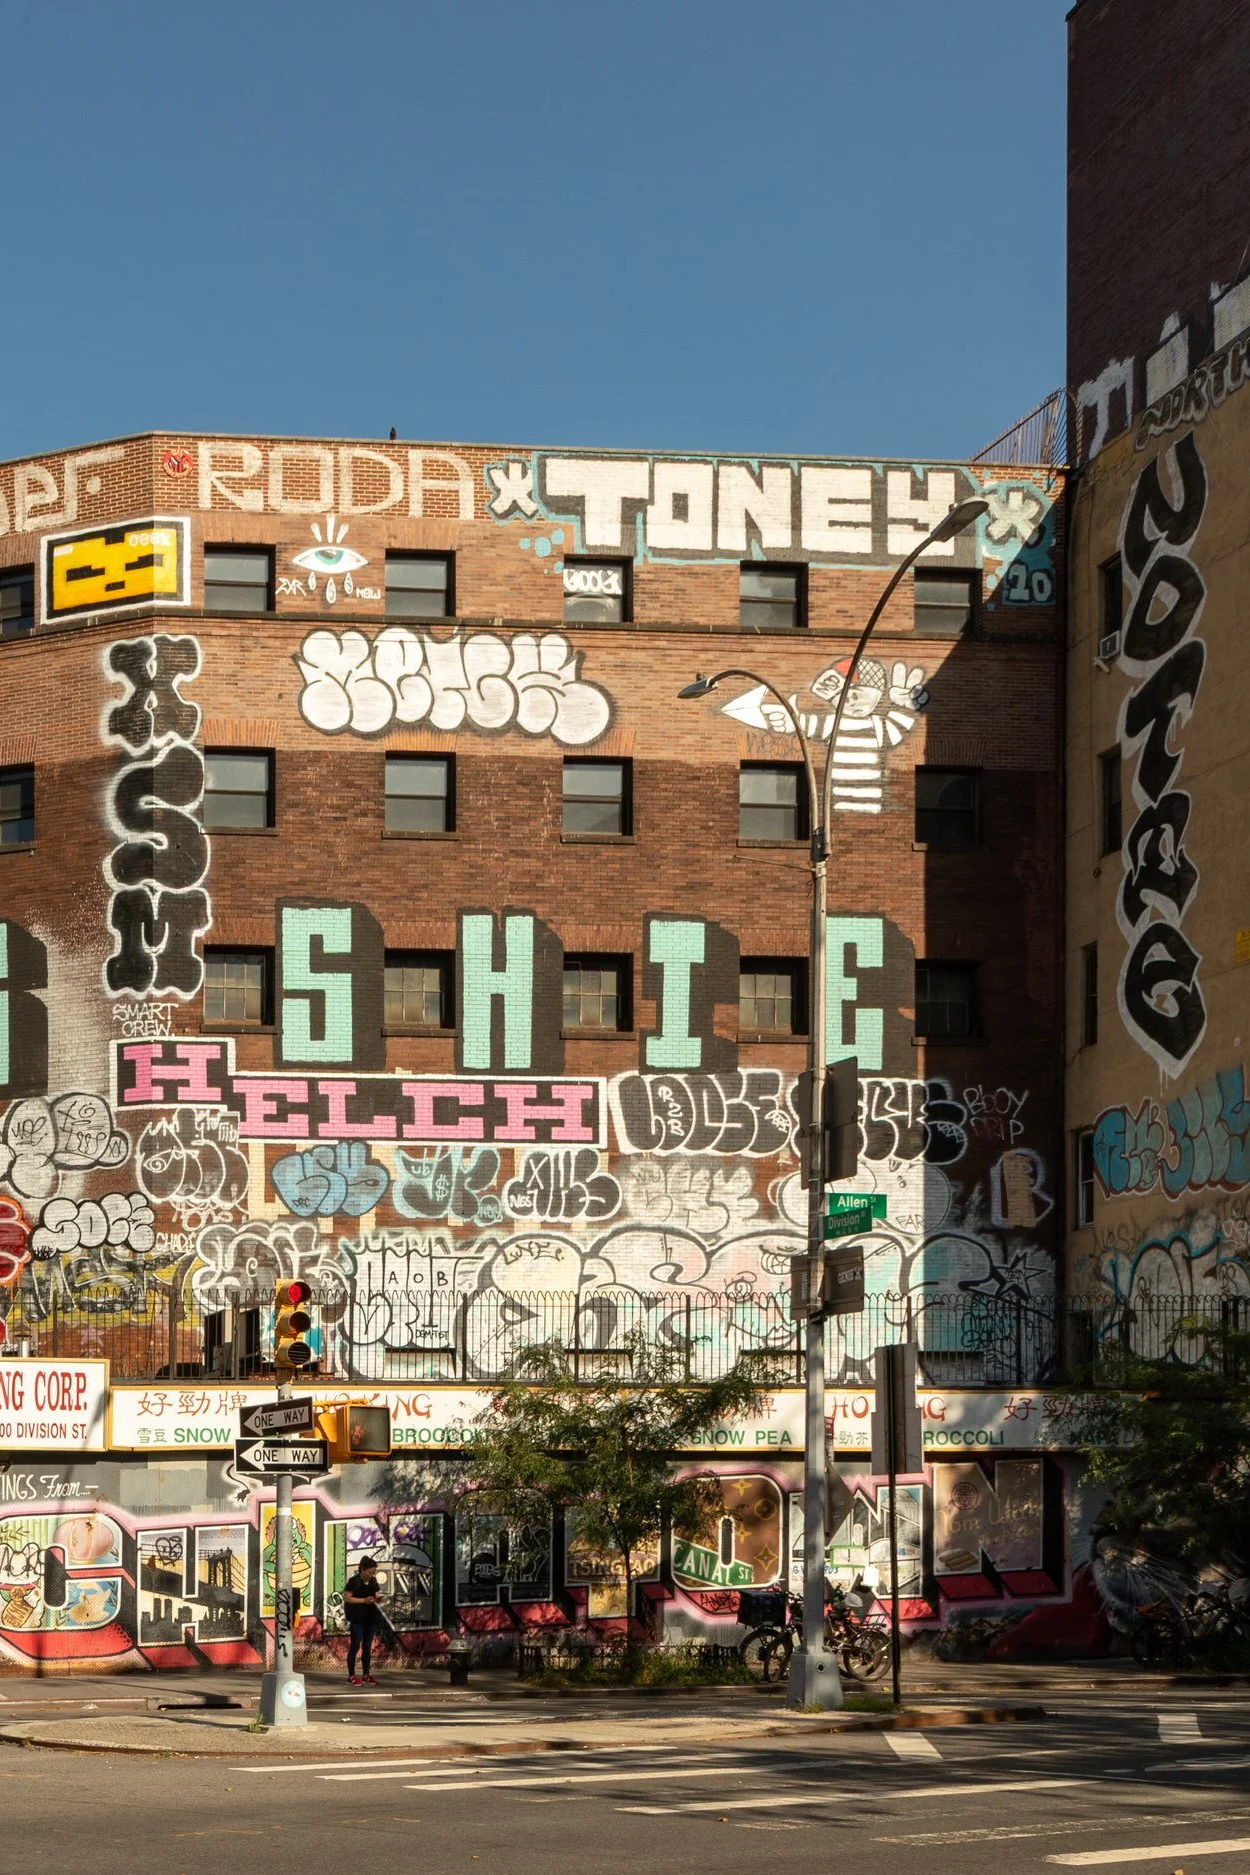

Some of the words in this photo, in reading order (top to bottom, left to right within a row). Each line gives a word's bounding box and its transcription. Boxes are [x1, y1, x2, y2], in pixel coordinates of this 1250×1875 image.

[112, 1002, 179, 1021] SMART
[122, 1043, 595, 1141] HELCH
[837, 1196, 868, 1208] Allen
[828, 1215, 860, 1230] Division
[35, 1371, 87, 1411] CORP.
[254, 1413, 274, 1429] ONE
[283, 1408, 305, 1424] WAY
[17, 1423, 67, 1438] DIVISION
[72, 1424, 87, 1439] ST.
[174, 1428, 231, 1443] SNOW
[690, 1430, 745, 1445] SNOW
[756, 1430, 792, 1445] PEA
[922, 1431, 1004, 1446] ROCCOLI
[253, 1450, 278, 1462] ONE
[291, 1450, 317, 1462] WAY
[570, 1558, 657, 1578] TSINGAO
[673, 1545, 734, 1587] CANAL
